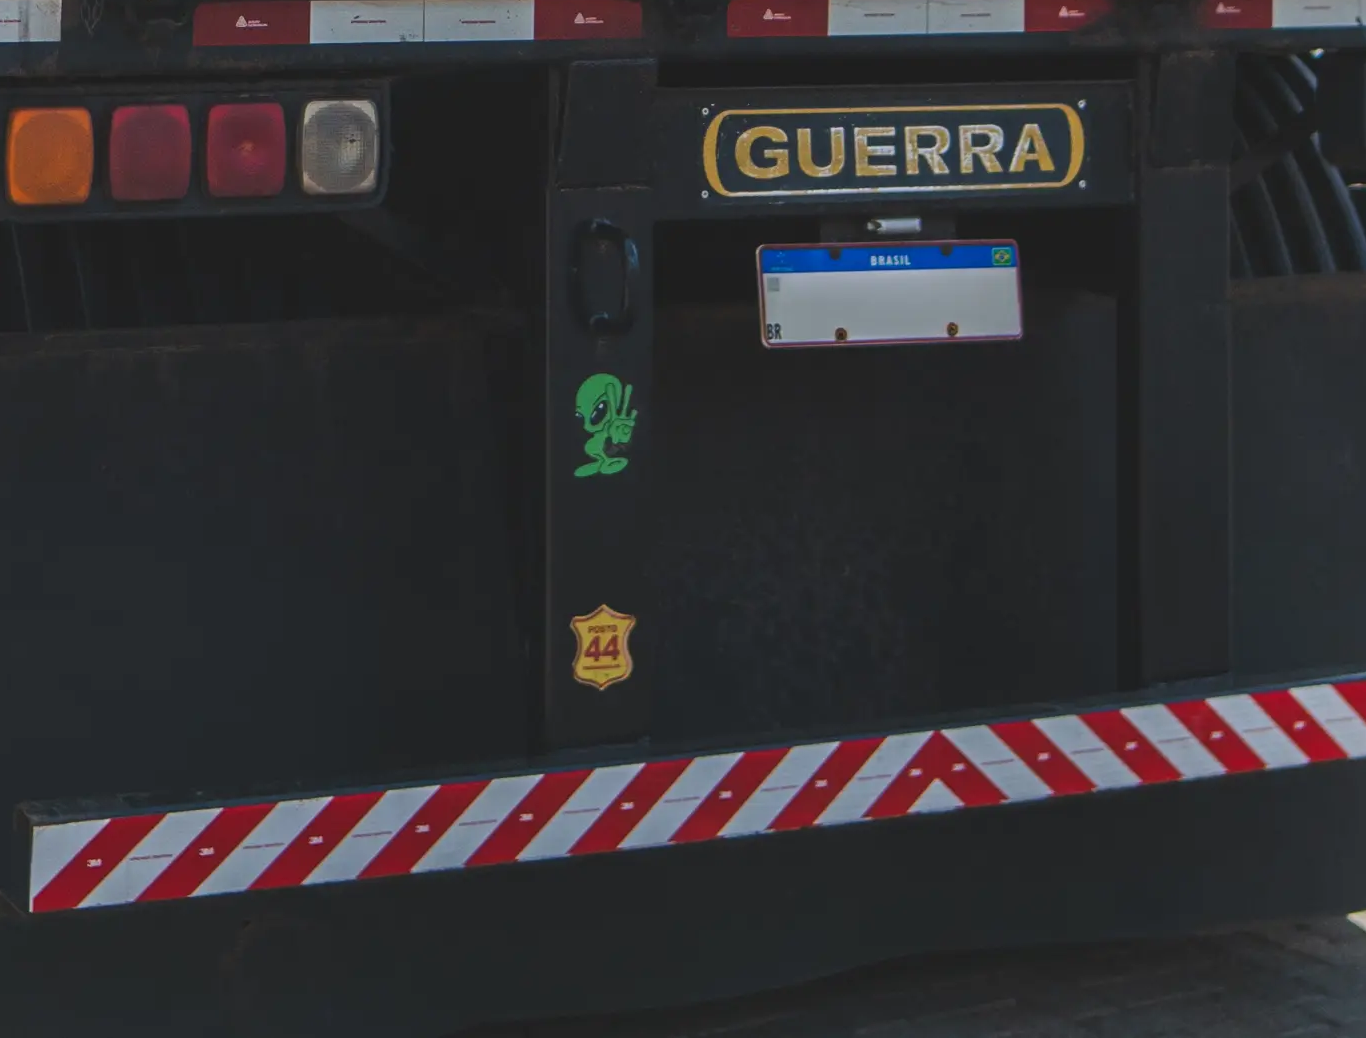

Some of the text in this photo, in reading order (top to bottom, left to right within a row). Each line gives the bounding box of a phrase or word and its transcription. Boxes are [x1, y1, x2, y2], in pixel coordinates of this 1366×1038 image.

[735, 123, 1055, 179] GUERRA
[870, 254, 912, 267] BRASIL
[766, 323, 782, 340] BR
[584, 633, 621, 662] 44
